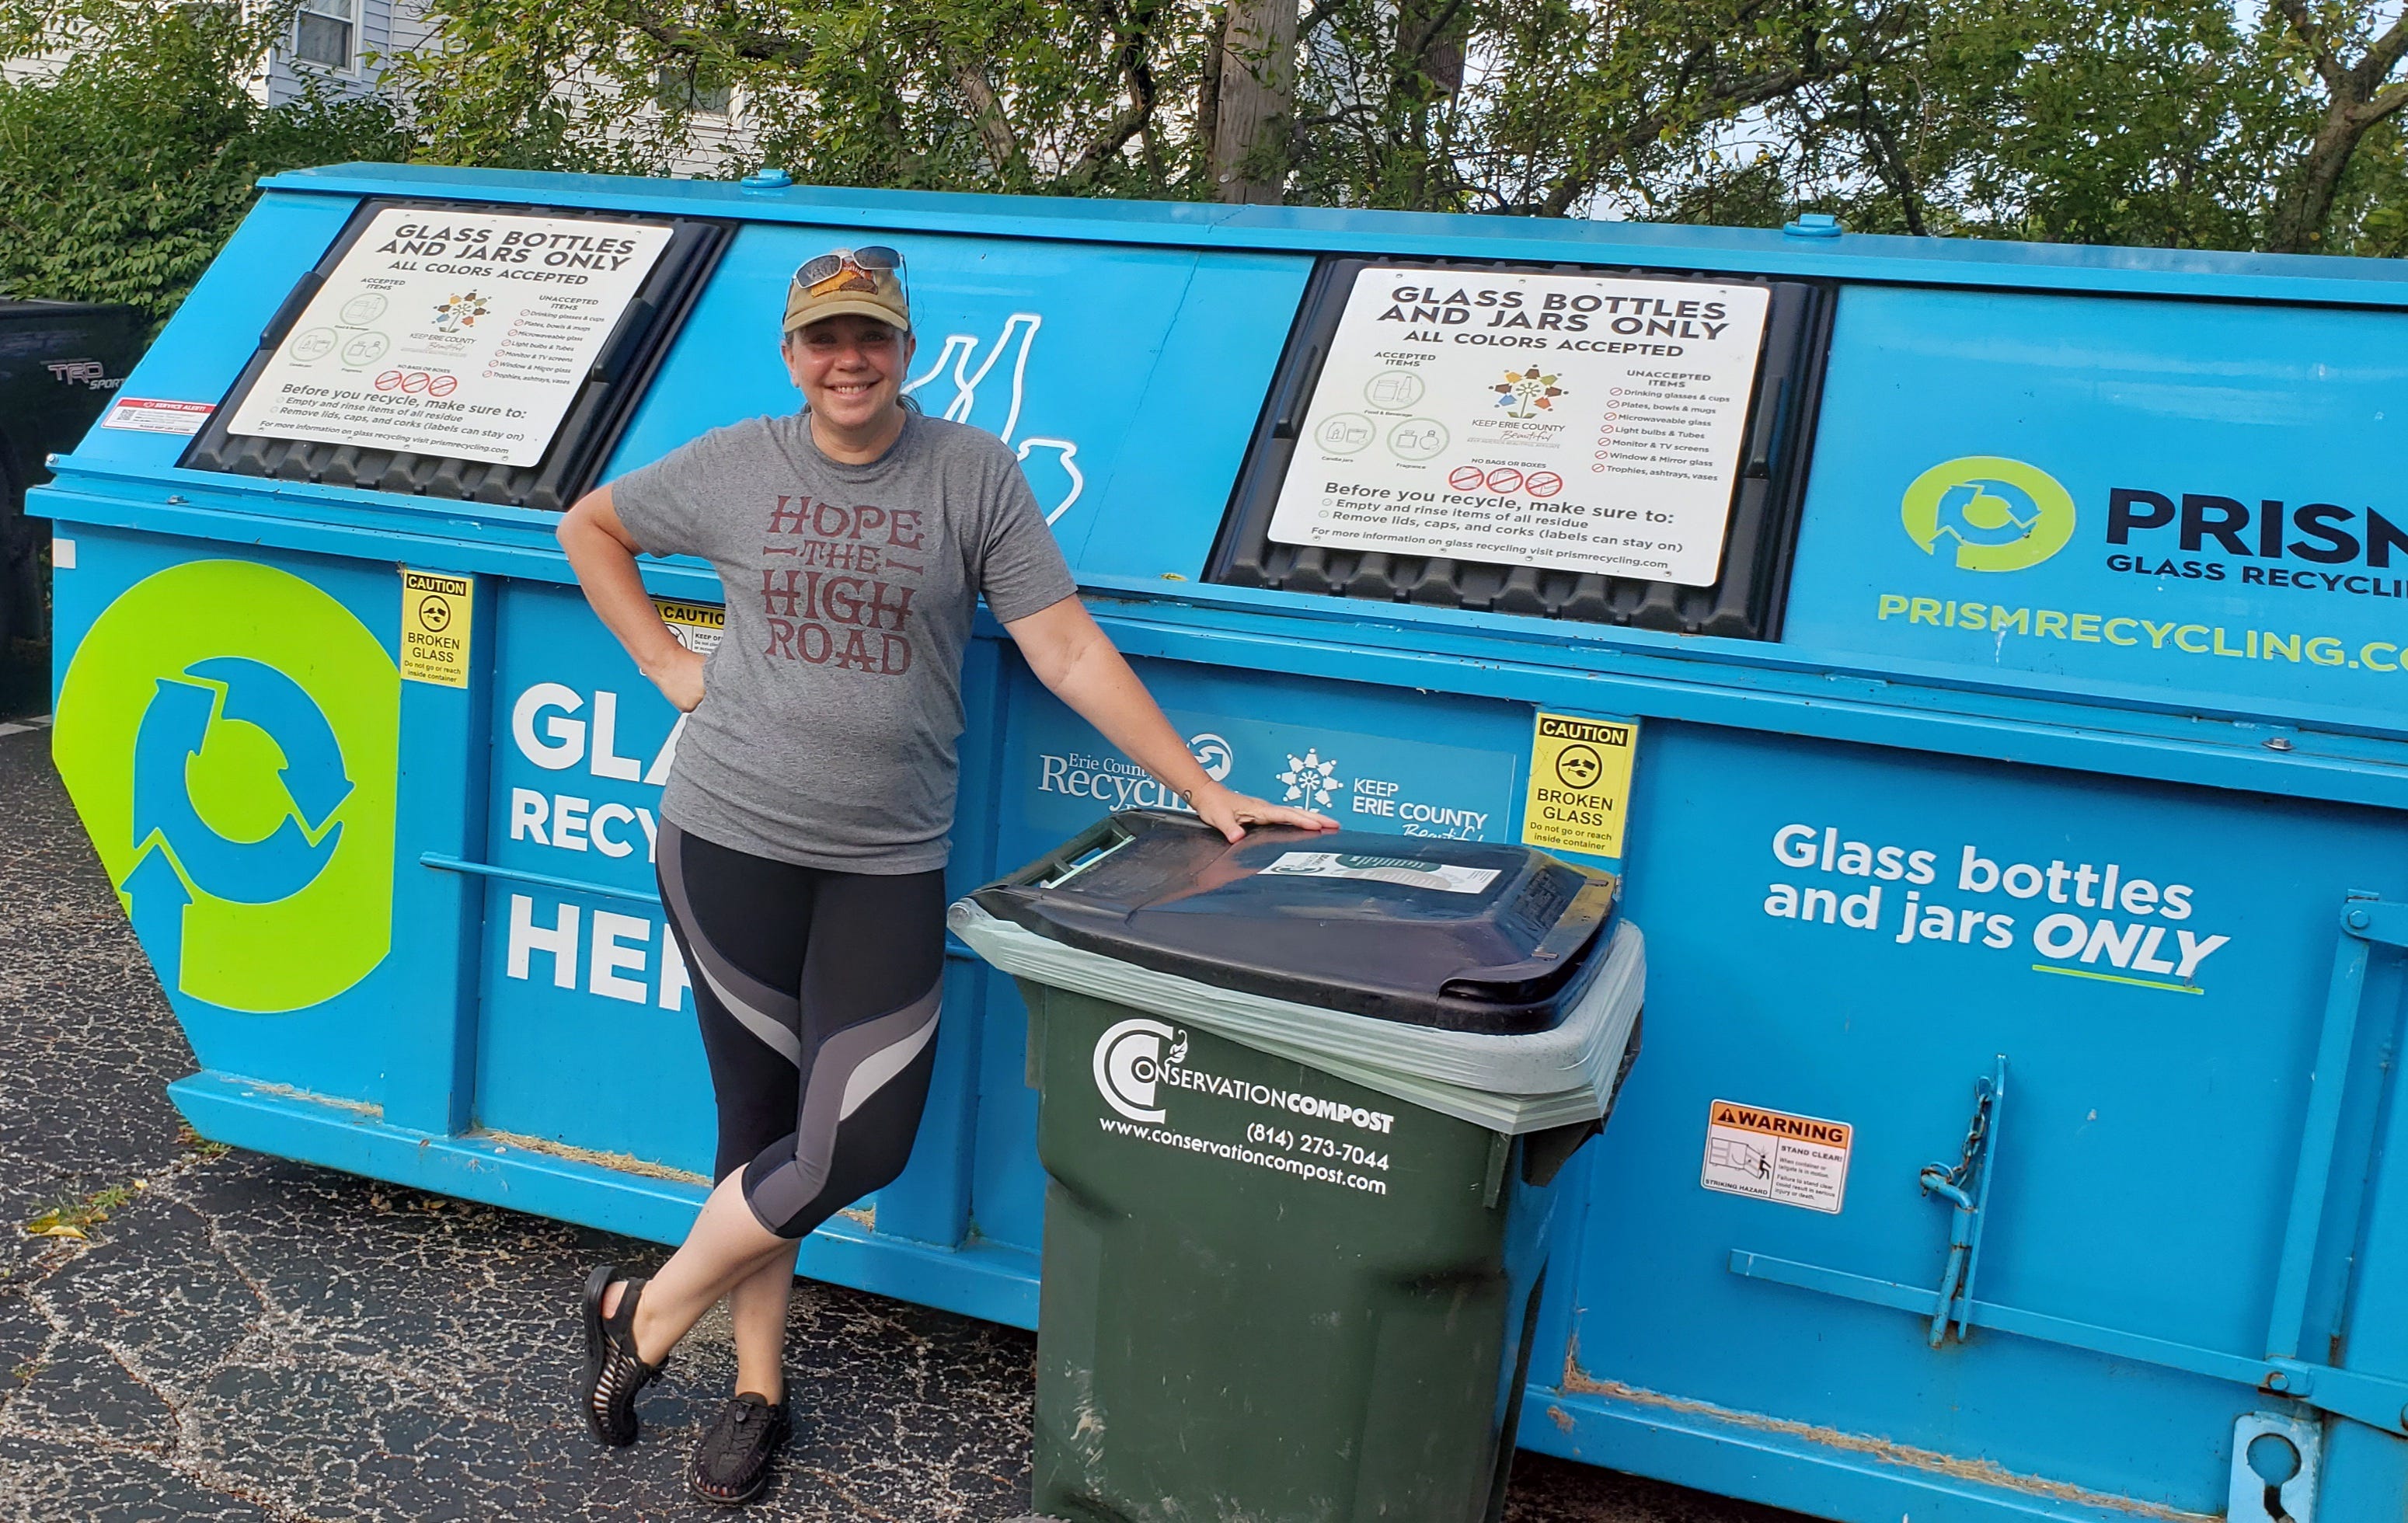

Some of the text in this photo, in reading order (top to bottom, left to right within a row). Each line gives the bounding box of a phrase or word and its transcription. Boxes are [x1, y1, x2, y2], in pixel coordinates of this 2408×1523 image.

[395, 224, 636, 254] GLASS BOTTLES
[375, 239, 631, 271] AND JARS ONLY
[360, 277, 406, 286] ACCEPTED
[388, 260, 588, 284] ALL COLORS ACCEPTED
[538, 294, 598, 305] UNACCEPTED
[1392, 286, 1726, 319] GLASS BOTTLES
[1376, 305, 1729, 340] AND JARS ONLY
[1403, 329, 1683, 357] ALL COLORS ACCEPTED
[1374, 351, 1436, 361] ACCEPTED
[47, 362, 104, 385] TRD
[1626, 369, 1711, 381] UNACCEPTED
[1648, 379, 1685, 388] ITEMS
[282, 383, 527, 419] Before you recycle, make sure to:
[1624, 389, 1662, 398] Drinking
[1621, 401, 1650, 410] Plates,
[1498, 420, 1520, 429] ERIE
[1521, 423, 1566, 432] COUNTY
[1618, 413, 1686, 424] Microwaveable
[1612, 439, 1648, 448] Monitor
[1609, 452, 1648, 461] Window
[1606, 465, 1647, 476] Trophies,
[1649, 469, 1690, 479] ashtrays,
[1324, 481, 1674, 524] Before you recycle, make sure to:
[1336, 498, 1588, 528] Empty and rinse items of all residue
[767, 495, 925, 550] HOPE
[1333, 511, 1682, 552] Remove lids, caps, and corks (labels can stay on)
[800, 540, 881, 574] THE
[1311, 527, 1329, 536] For
[1362, 531, 1425, 543] information
[1445, 537, 1473, 549] glass
[1476, 542, 1527, 556] recycling
[1530, 546, 1554, 556] visit
[1556, 549, 1669, 570] prismrecycling.com
[408, 576, 465, 595] CAUTION
[2106, 554, 2408, 599] GLASS RECYCLI
[760, 569, 916, 632] HIGH
[407, 632, 460, 650] BROKEN
[1877, 594, 2408, 672] PRISMRECYCLING.C
[412, 646, 455, 663] GLASS
[764, 617, 912, 676] ROAD
[427, 673, 458, 683] container
[443, 667, 461, 675] reach
[1542, 720, 1625, 744] CAUTION
[1068, 752, 1153, 779] Erie Count
[1354, 777, 1399, 797] KEEP
[1537, 788, 1613, 811] BROKEN
[1352, 795, 1488, 830] ERIE COUNTY
[1542, 806, 1603, 826] GLASS
[1530, 821, 1542, 830] Do
[1545, 824, 1559, 833] not
[1562, 828, 1573, 836] go
[1587, 831, 1612, 841] reach
[1534, 833, 1605, 850] inside container
[1772, 823, 2194, 920] Glass bottles
[1763, 882, 2232, 978] and jars ONLY
[1737, 1110, 1843, 1143] WARNING
[1099, 1117, 1387, 1196] www.conservationcompost.com
[1246, 1122, 1390, 1172] (814) 273-7044
[1781, 1145, 1843, 1162] STAND CLEAR!
[1706, 1178, 1769, 1196] STRIKING HAZARD
